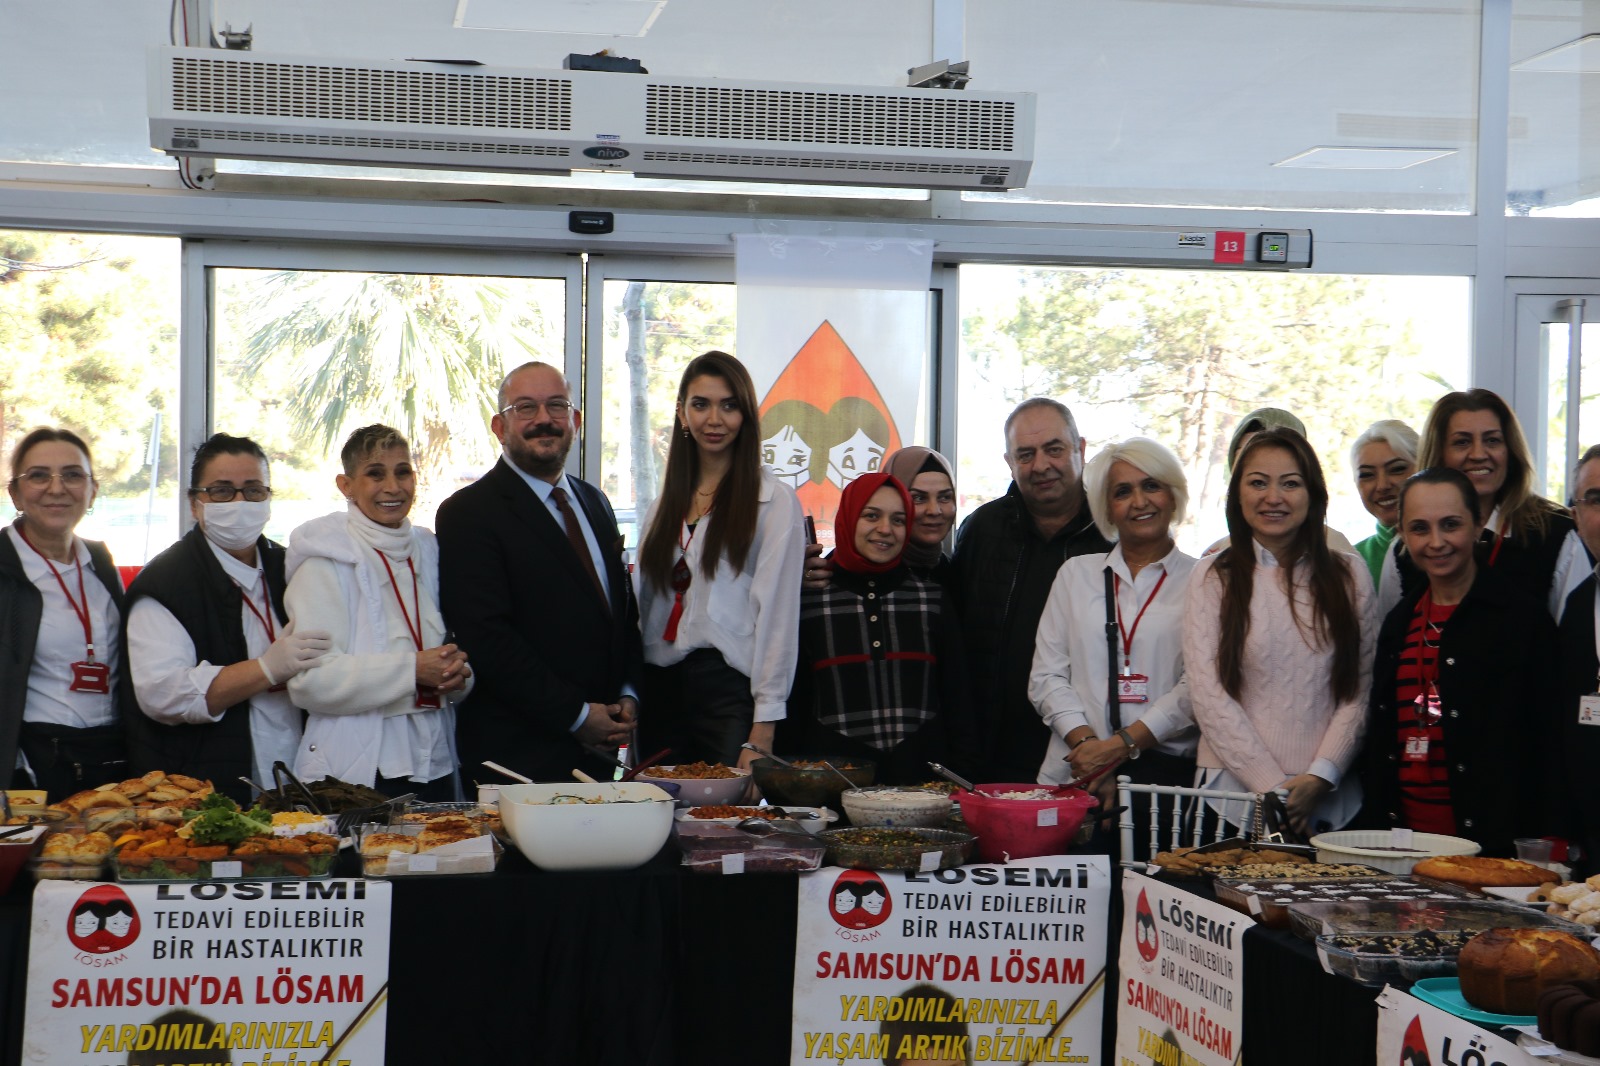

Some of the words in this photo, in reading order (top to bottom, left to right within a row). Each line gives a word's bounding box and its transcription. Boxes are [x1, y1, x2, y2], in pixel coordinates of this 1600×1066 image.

[1223, 240, 1238, 252] 13
[153, 906, 233, 929] TEDAVİ
[244, 906, 365, 929] EDİLEBİLİR
[903, 891, 972, 911] TEDAVİ
[981, 892, 1087, 915] EDİLEBİLİR
[902, 915, 938, 939] BİR
[948, 920, 1085, 943] HASTALIKTIR
[1158, 898, 1236, 951] LÖSEMİ
[153, 935, 194, 960] BİR
[206, 937, 364, 960] HASTALIKTIR
[1160, 929, 1187, 959] TEDAVİ
[1189, 943, 1234, 981] EDİLEBİLİR
[989, 948, 1085, 985] LÖSAM
[255, 967, 364, 1006] LÖSAM
[1161, 956, 1175, 982] BİR
[1178, 965, 1233, 1012] HASTALIKTIR
[839, 995, 1058, 1025] YARDIMLARINIZLA
[80, 1021, 335, 1053] YARDIMLARINIZLA
[803, 1032, 891, 1066] YAŞAM
[895, 1034, 970, 1061] ARTIK
[1193, 1007, 1232, 1061] LÖSAM
